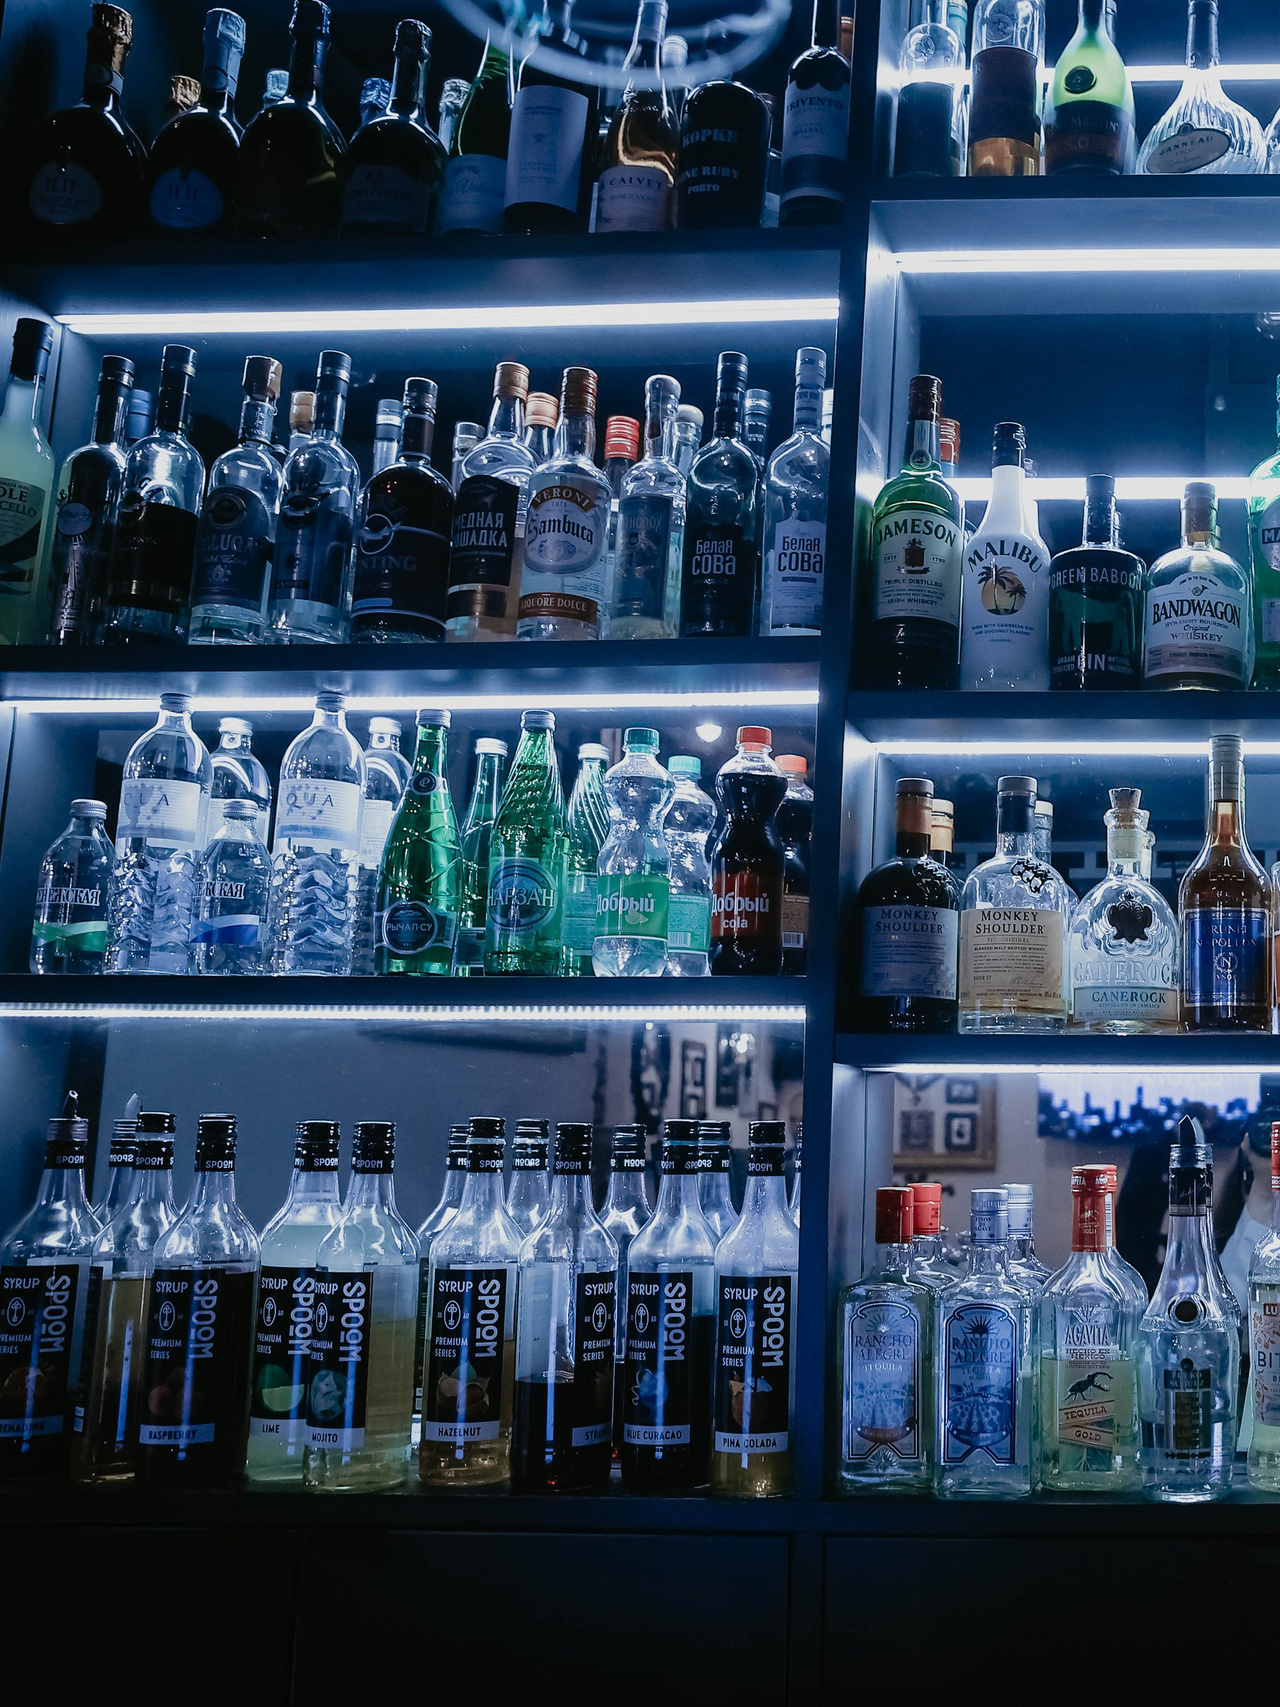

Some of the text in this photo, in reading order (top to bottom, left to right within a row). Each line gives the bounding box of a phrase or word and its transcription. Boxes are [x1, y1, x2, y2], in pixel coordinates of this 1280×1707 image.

[786, 97, 844, 114] TRIVENTO
[682, 128, 739, 148] KOPKE
[1159, 136, 1213, 155] JANNEAU
[702, 166, 740, 180] RUBY
[610, 176, 663, 190] CALVET
[688, 183, 720, 194] PORTO
[535, 487, 590, 508] VERONI
[455, 512, 504, 530] МЕДНАЯ
[528, 514, 594, 546] Sambuca
[877, 518, 956, 547] JAMESON
[967, 540, 1042, 572] MALIBU
[908, 579, 942, 588] DISTILLED
[1050, 567, 1142, 591] GREEN BABOON
[521, 597, 587, 612] LIQUORE DOLCE
[1152, 599, 1241, 629] BANDWAGON
[1183, 625, 1209, 633] Original
[1171, 632, 1223, 642] WHISKEY
[488, 887, 556, 909] НАРЗАН
[596, 892, 656, 916] Добрый
[711, 892, 770, 917] Добрый
[881, 909, 939, 921] MONKEY
[981, 910, 1039, 922] MONKEY
[722, 917, 748, 928] cola
[875, 921, 945, 934] SHOULDER
[975, 923, 1045, 934] SHOULDER
[1091, 991, 1166, 1003] CANEROCK
[136, 1156, 164, 1166] SPOOM
[205, 1160, 234, 1170] SPOOM
[555, 1160, 582, 1170] SPOOM
[3, 1277, 40, 1290] SYRUP
[155, 1281, 188, 1294] SYRUP
[261, 1277, 288, 1290] SYRUP
[314, 1282, 338, 1295] SYRUP
[438, 1280, 473, 1293] SYRUP
[584, 1282, 614, 1296] SYRUP
[630, 1283, 659, 1297] SYRUP
[724, 1287, 758, 1300] SYRUP
[39, 1274, 71, 1354] SPOOM
[189, 1278, 219, 1359] SPOOM
[288, 1276, 314, 1356] SPOOM
[475, 1278, 501, 1358] SPOOM
[338, 1281, 366, 1362] SPOOM
[664, 1281, 687, 1361] SPOOM
[762, 1286, 785, 1367] SPOOM
[256, 1333, 282, 1344] PREMIUM
[435, 1336, 468, 1347] PREMIUM
[855, 1334, 912, 1347] RANCHO
[1064, 1325, 1111, 1346] AGAVITA
[151, 1338, 182, 1348] PREMIUM
[583, 1338, 611, 1350] PREMIUM
[628, 1338, 656, 1350] PREMIUM
[952, 1337, 1010, 1349] RANCHO
[150, 1350, 170, 1360] SERIES
[256, 1345, 272, 1355] SERIES
[435, 1348, 457, 1358] SERIES
[582, 1351, 605, 1361] SERIES
[628, 1351, 646, 1361] SERIES
[722, 1345, 755, 1356] PREMIUM
[858, 1348, 910, 1361] ALEGRE
[722, 1356, 744, 1367] SERIES
[954, 1351, 1010, 1363] ALEGRE
[1064, 1406, 1107, 1420] TEQUILA
[0, 1421, 46, 1433] RENADINE
[262, 1424, 280, 1433] LIME
[438, 1427, 481, 1437] HAZELNUT
[149, 1429, 198, 1440] RASPBERRY
[312, 1433, 338, 1443] MOJITO
[627, 1429, 682, 1440] BLUE CURACAO
[1074, 1430, 1102, 1442] GOLD
[723, 1437, 777, 1448] PINA COLADA
